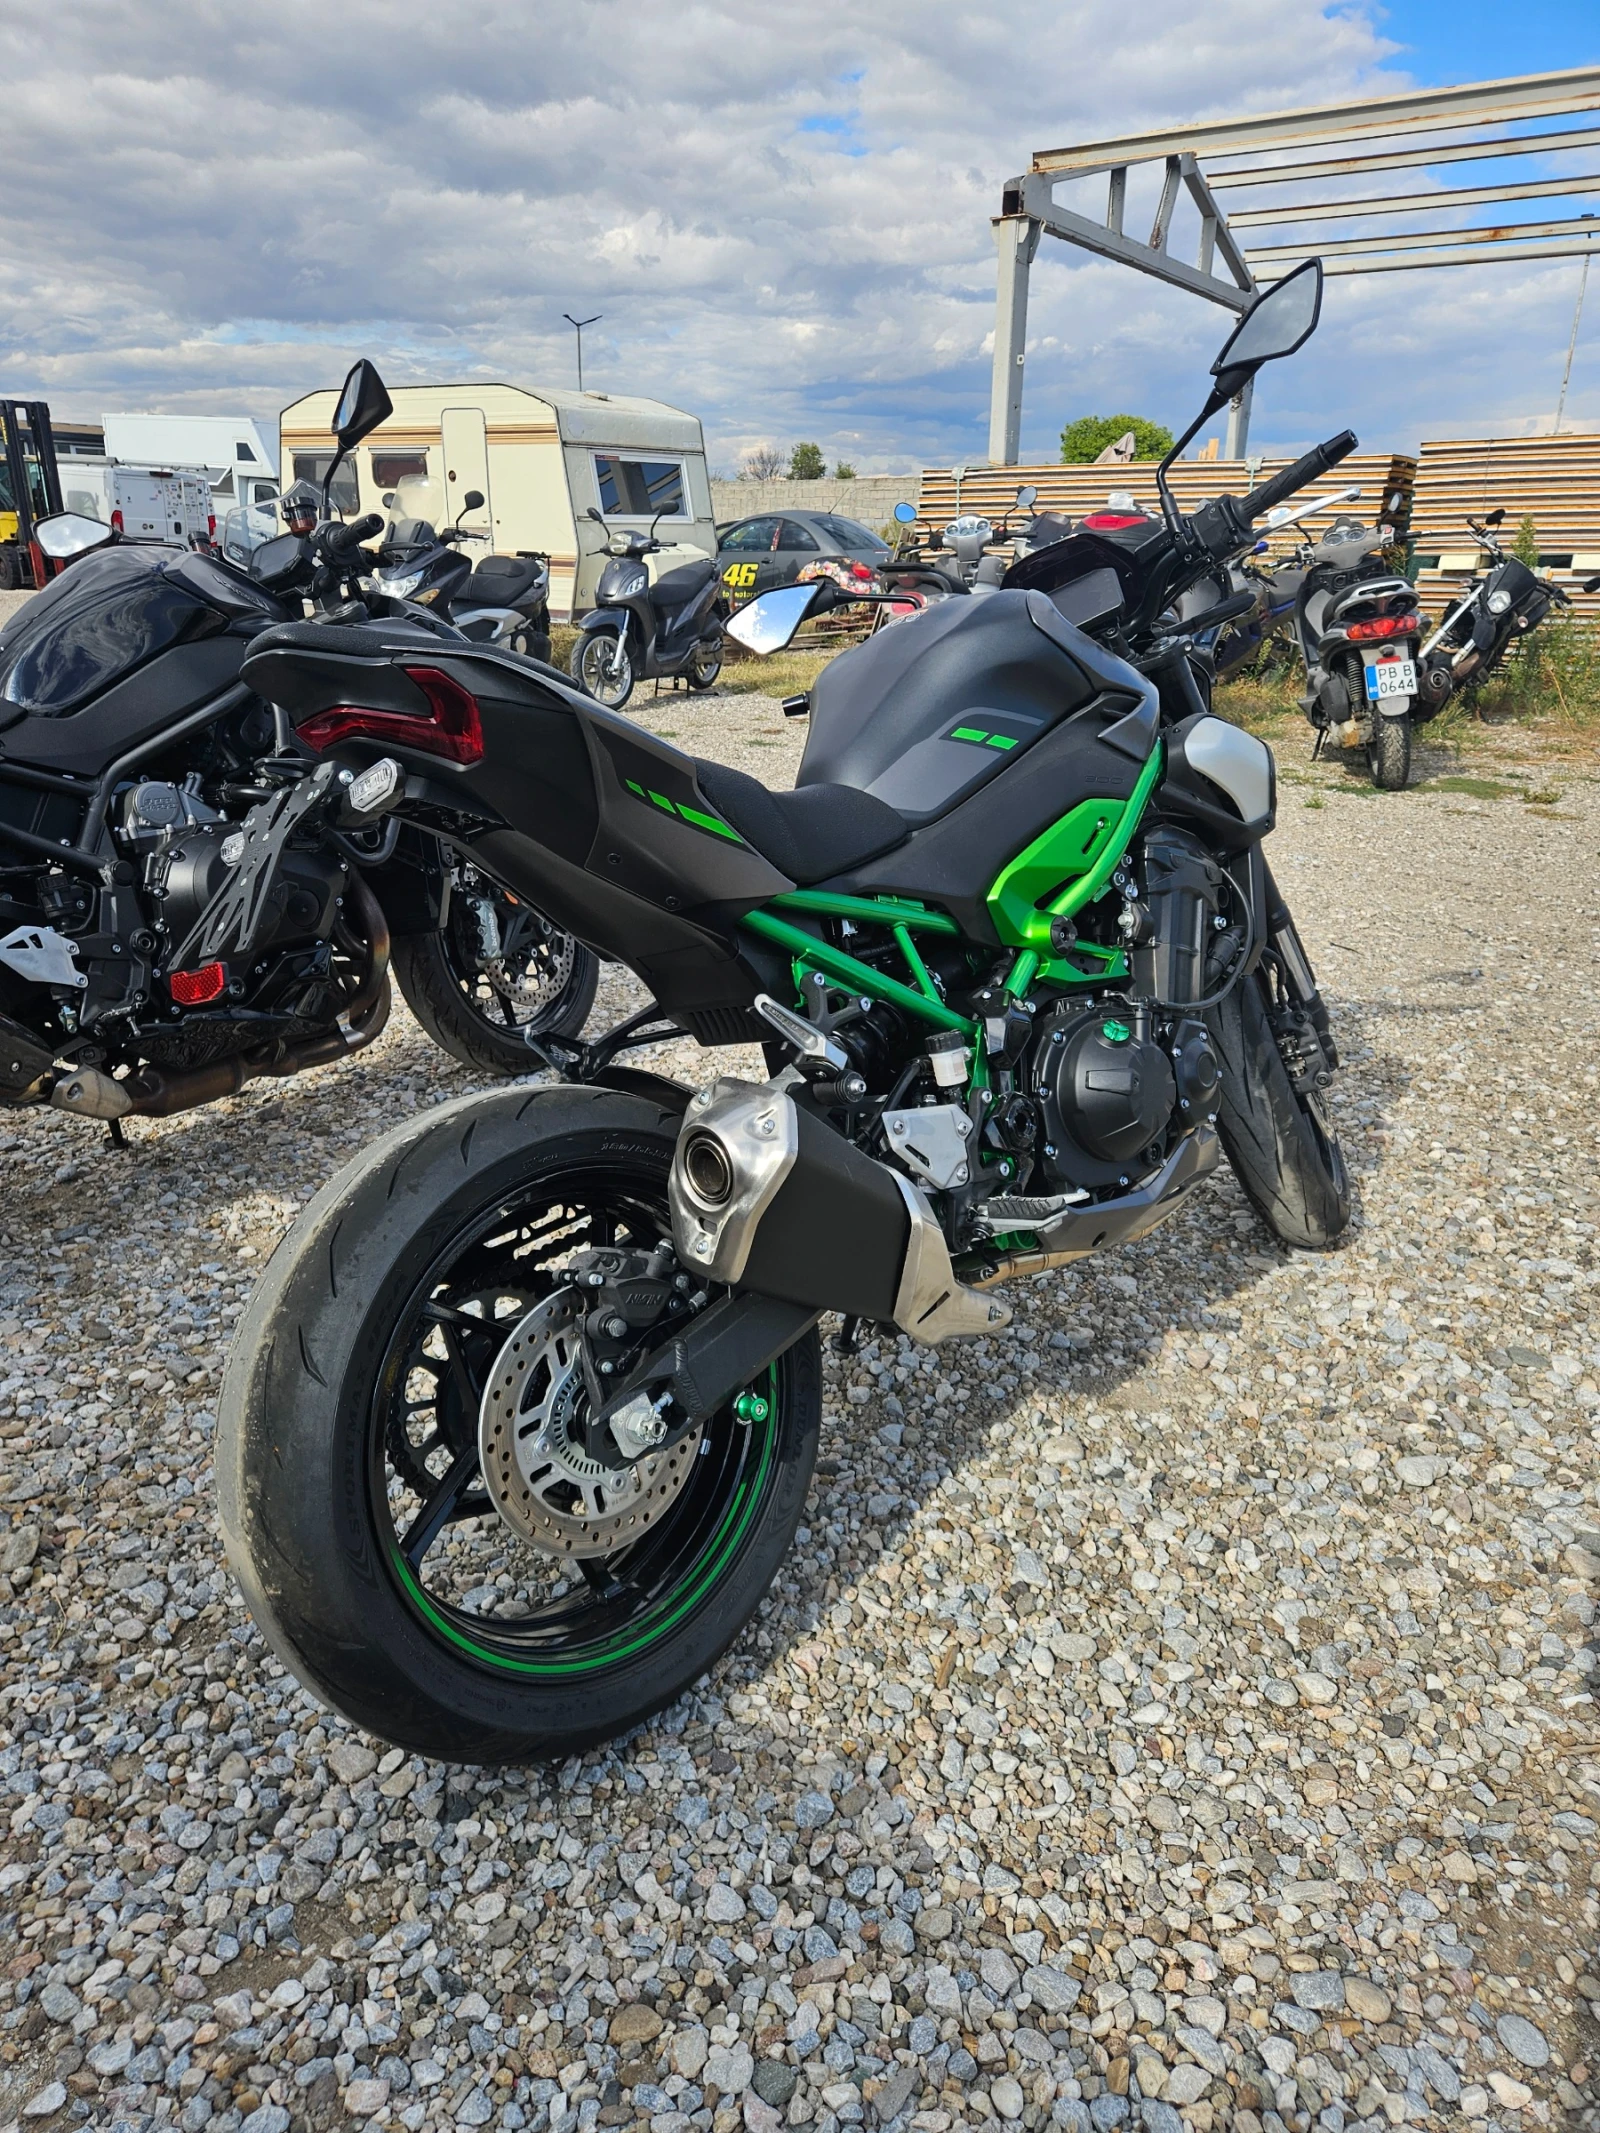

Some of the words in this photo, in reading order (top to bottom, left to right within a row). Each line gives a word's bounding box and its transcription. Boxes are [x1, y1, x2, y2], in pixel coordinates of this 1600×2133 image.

[722, 563, 759, 587] 46
[1378, 667, 1397, 680] PB
[1403, 664, 1412, 677] B
[1380, 678, 1414, 694] 0644
[488, 912, 499, 947] brembo
[344, 1362, 369, 1537] SPORTMAX
[783, 1402, 808, 1498] DUNLOP
